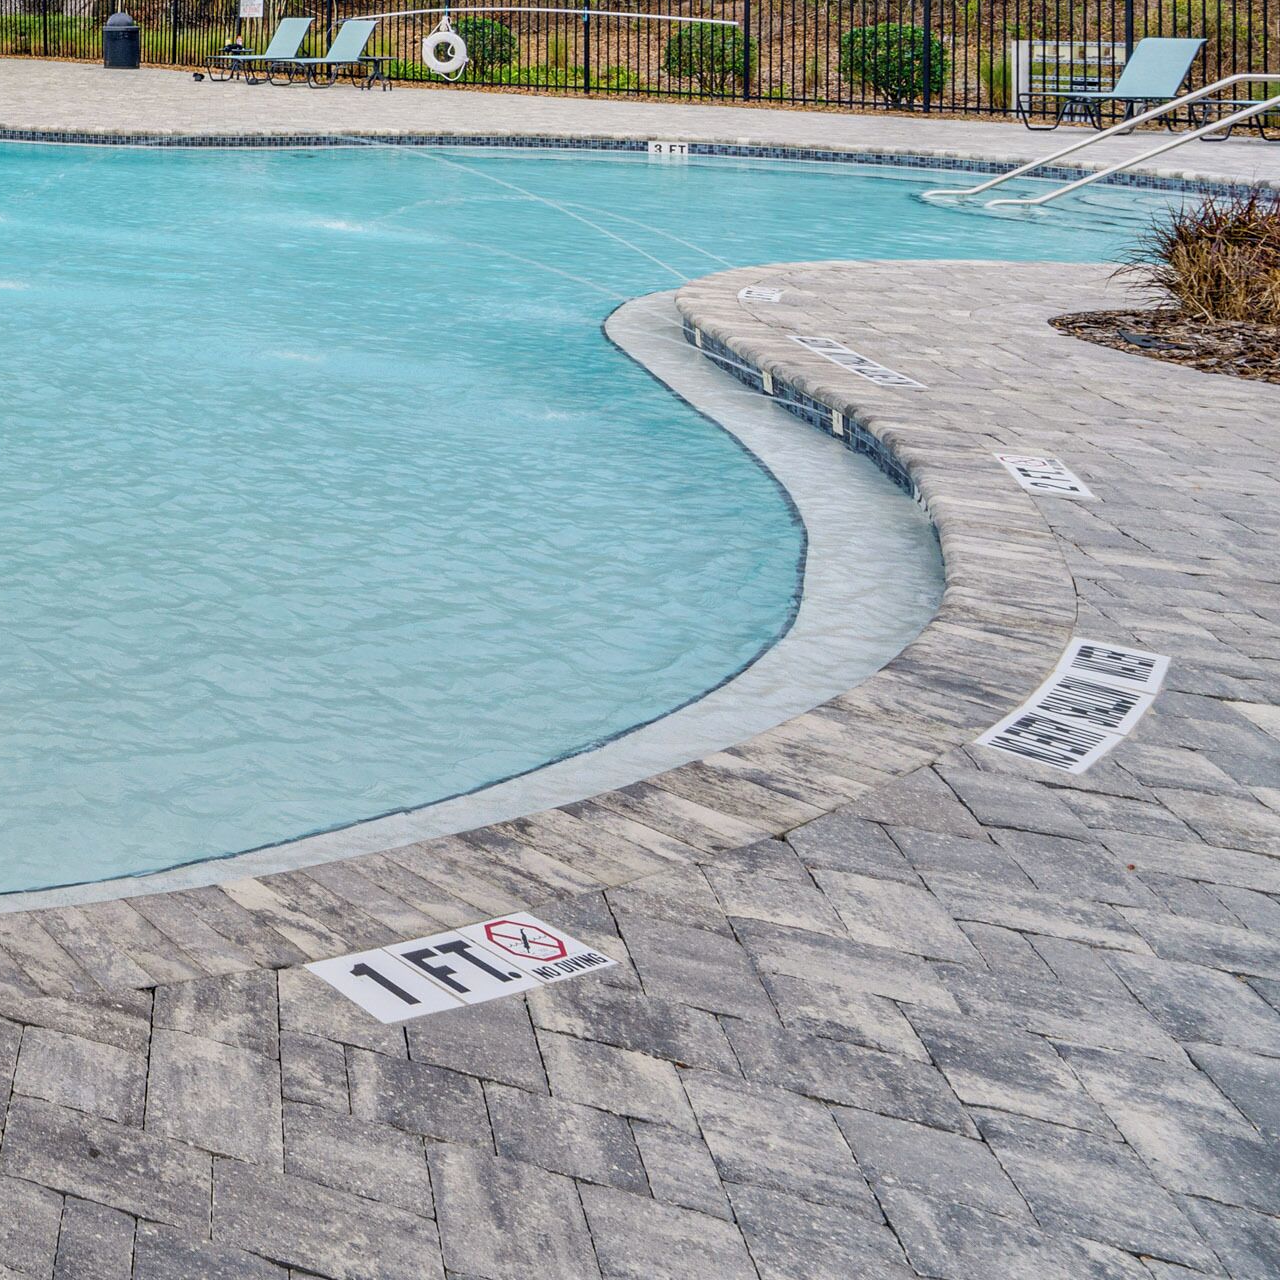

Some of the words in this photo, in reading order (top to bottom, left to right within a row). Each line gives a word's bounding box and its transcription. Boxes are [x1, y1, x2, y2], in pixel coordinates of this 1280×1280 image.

[669, 144, 686, 154] FT
[1070, 645, 1156, 683] WATER
[1036, 675, 1141, 728] SHALLOW
[988, 735, 1079, 769] NO
[1003, 712, 1107, 756] ENTRY
[349, 962, 422, 1005] 1
[400, 939, 523, 994] FT.
[531, 965, 562, 980] NO
[553, 952, 609, 974] DIVING
